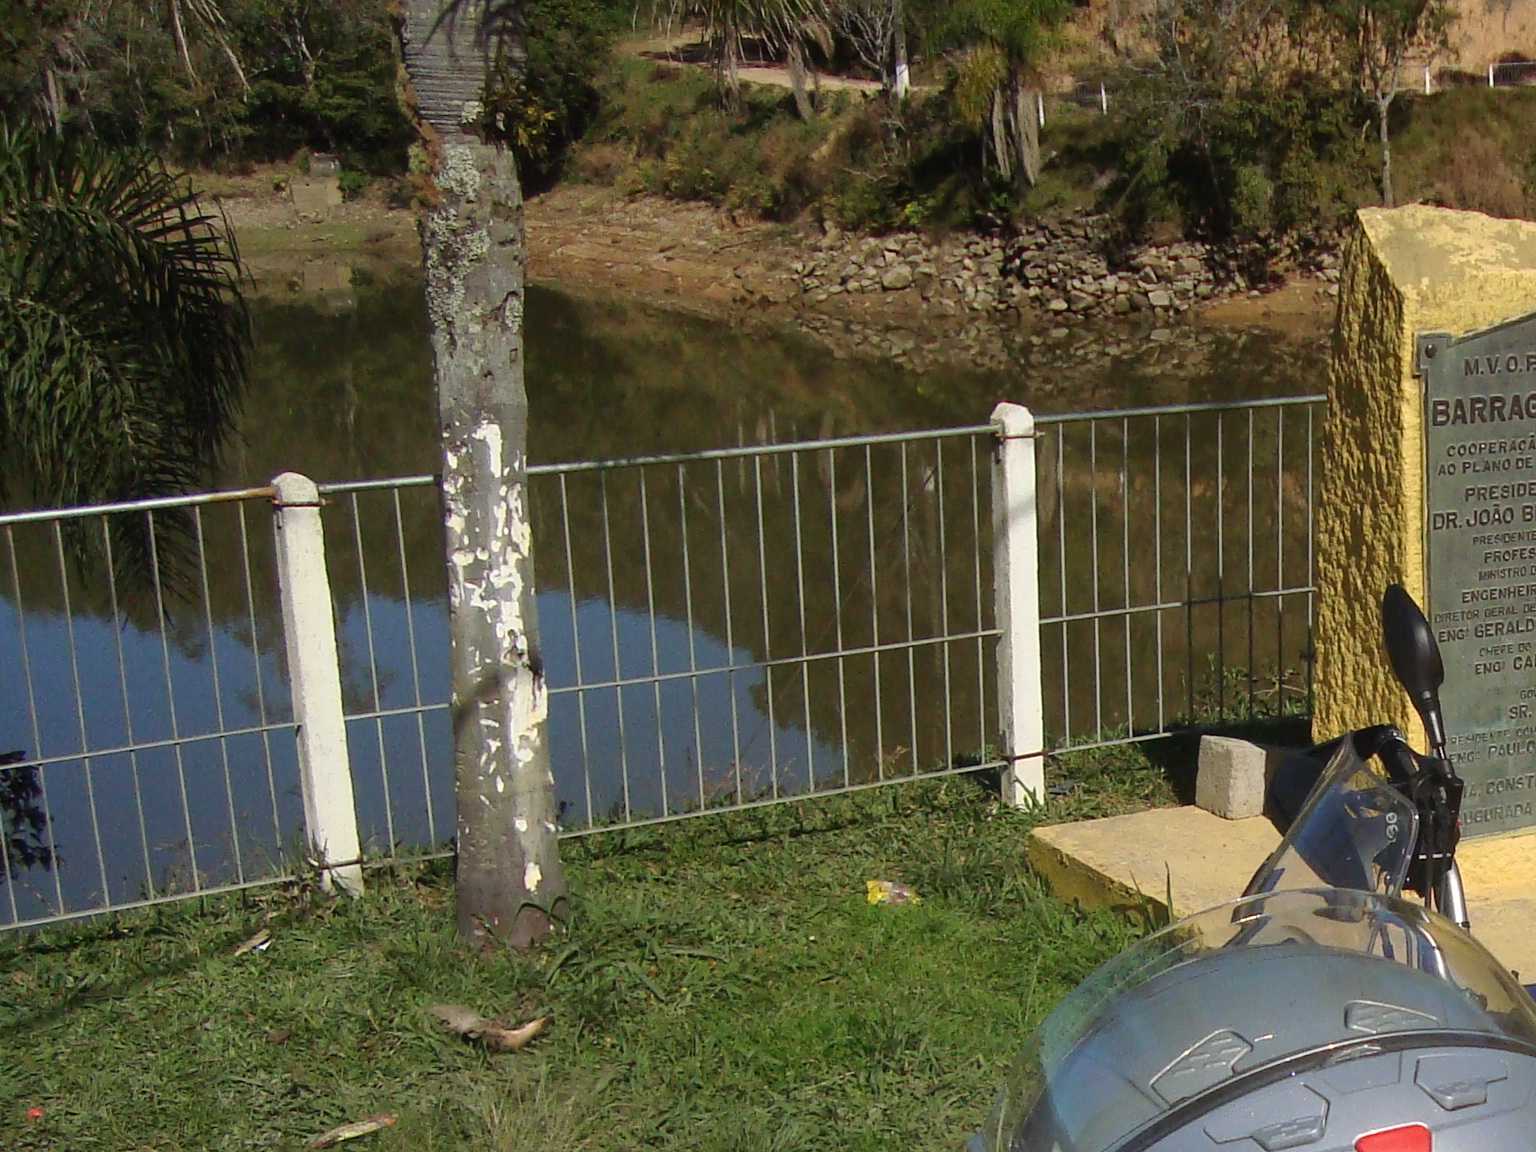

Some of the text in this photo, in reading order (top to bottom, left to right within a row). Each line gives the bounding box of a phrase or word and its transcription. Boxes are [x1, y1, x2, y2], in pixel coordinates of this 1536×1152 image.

[1438, 462, 1457, 476] AO
[1462, 457, 1512, 476] PLANO
[1516, 456, 1534, 470] DE
[1432, 511, 1463, 530] DR.
[1466, 503, 1515, 528] JOÃO
[1478, 565, 1527, 581] MINISTRO
[1434, 609, 1480, 623] DIRETOR
[1484, 605, 1519, 618] GERAL
[1479, 644, 1515, 657] CHEFE
[1508, 705, 1533, 720] SR.
[1487, 740, 1536, 760] PAULO
